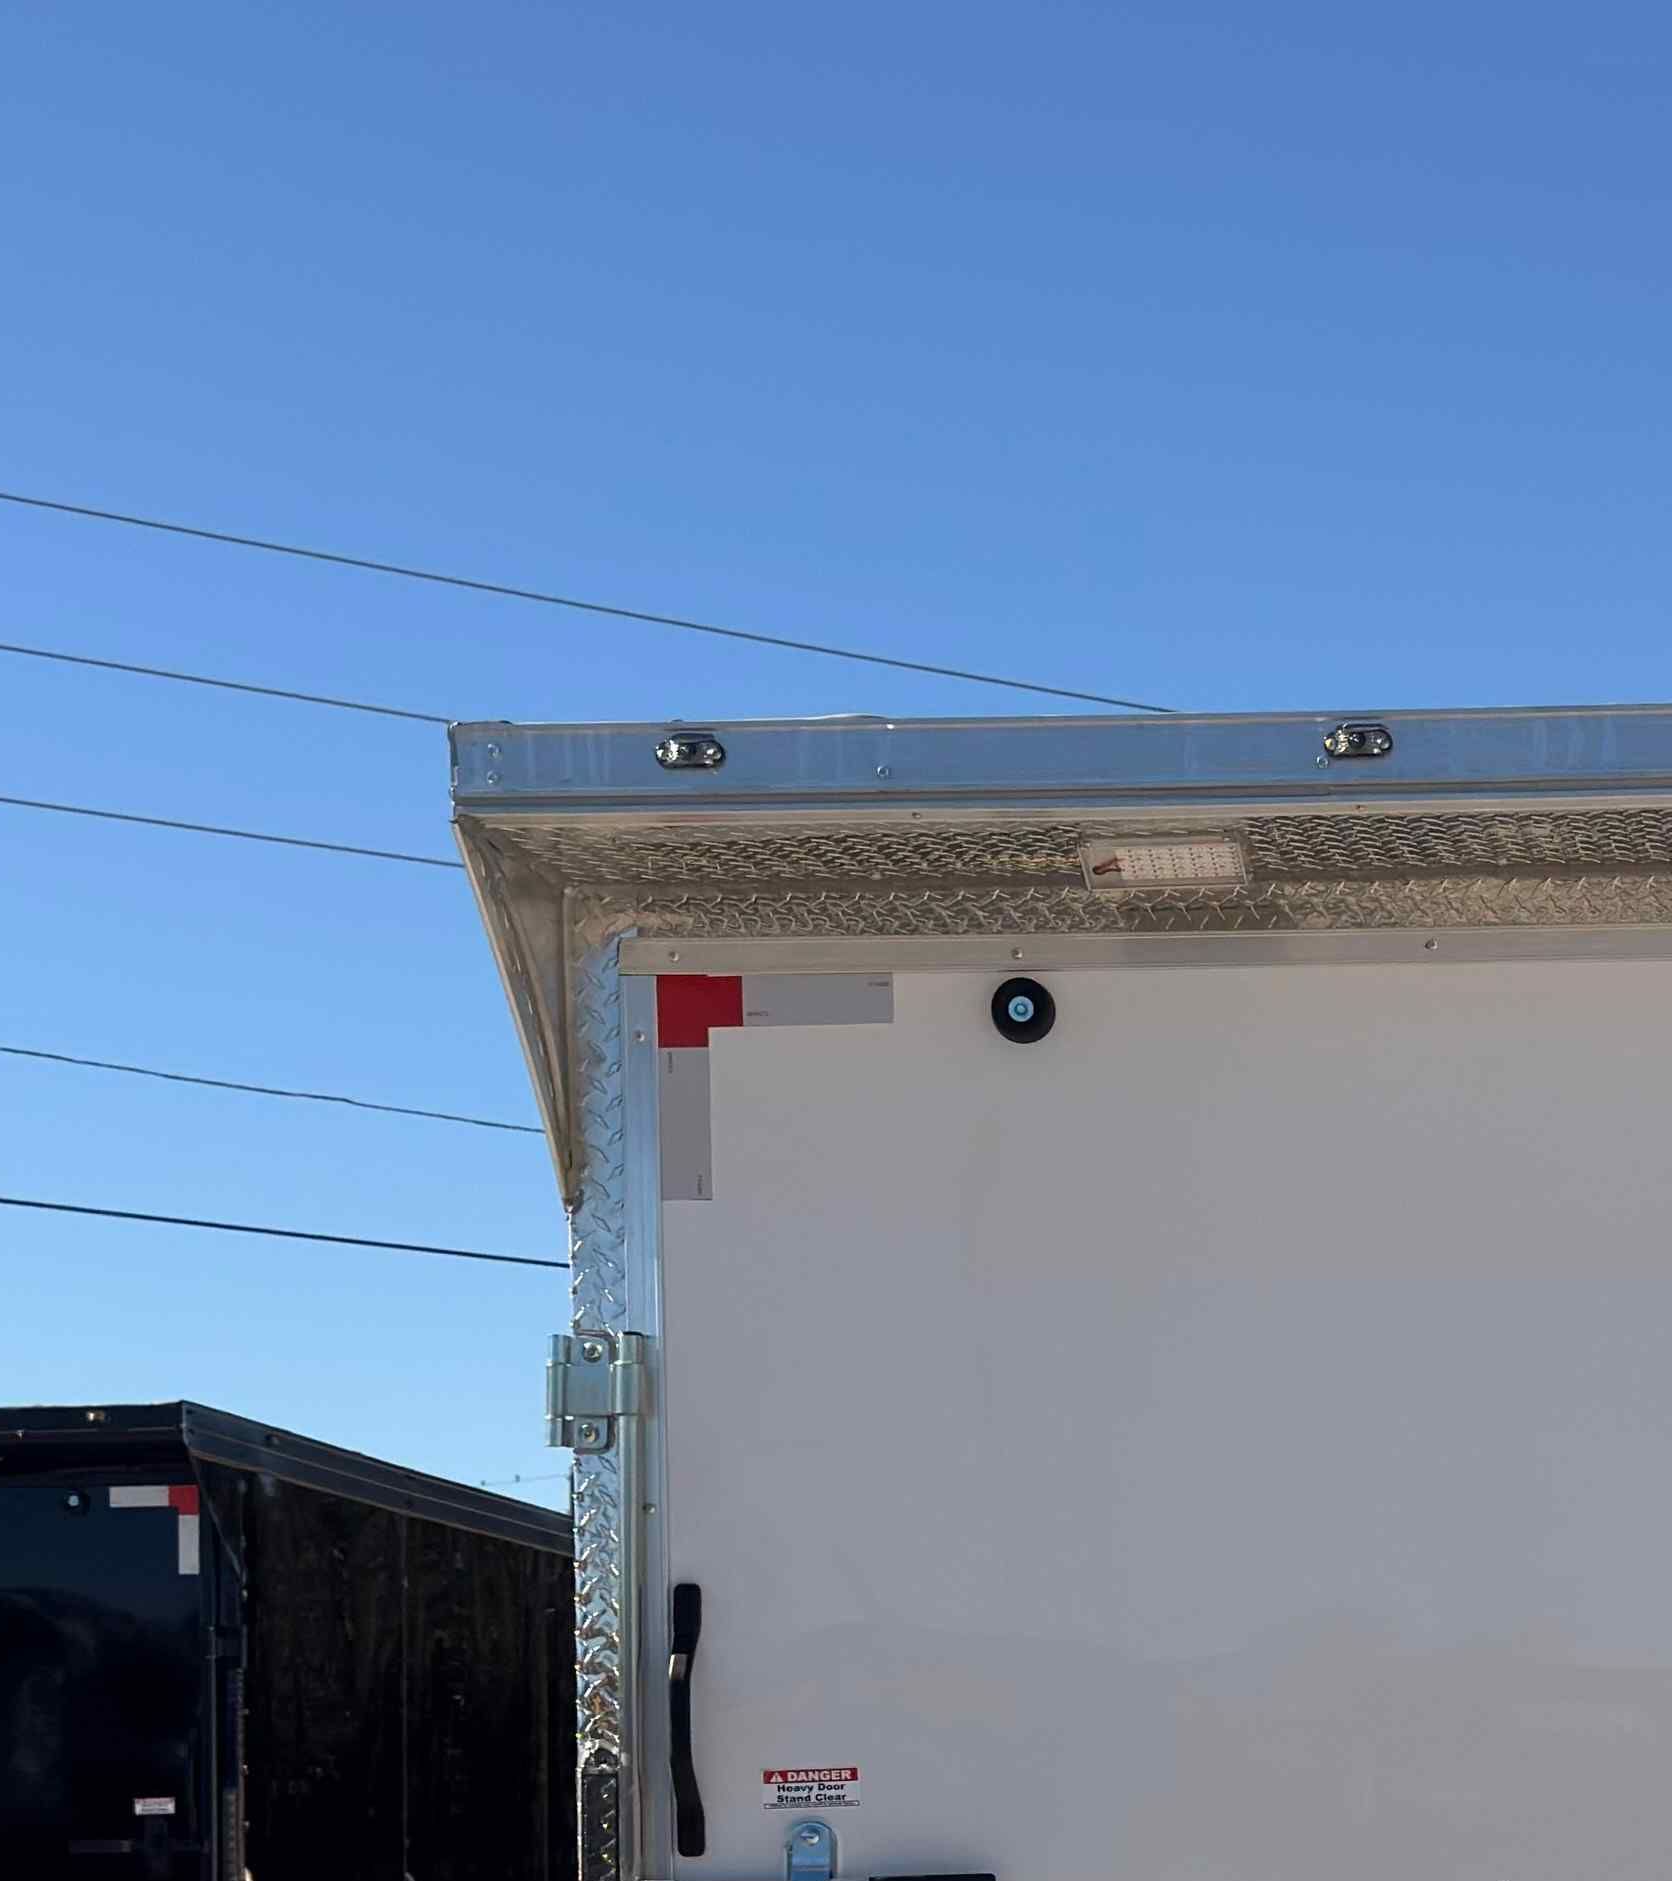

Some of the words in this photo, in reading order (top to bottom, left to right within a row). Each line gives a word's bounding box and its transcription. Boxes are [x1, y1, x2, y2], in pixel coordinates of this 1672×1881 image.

[787, 1769, 852, 1782] DANGER
[777, 1783, 813, 1793] Heavy
[818, 1782, 846, 1791] Door
[776, 1793, 811, 1803] Stand
[815, 1792, 847, 1802] Clear
